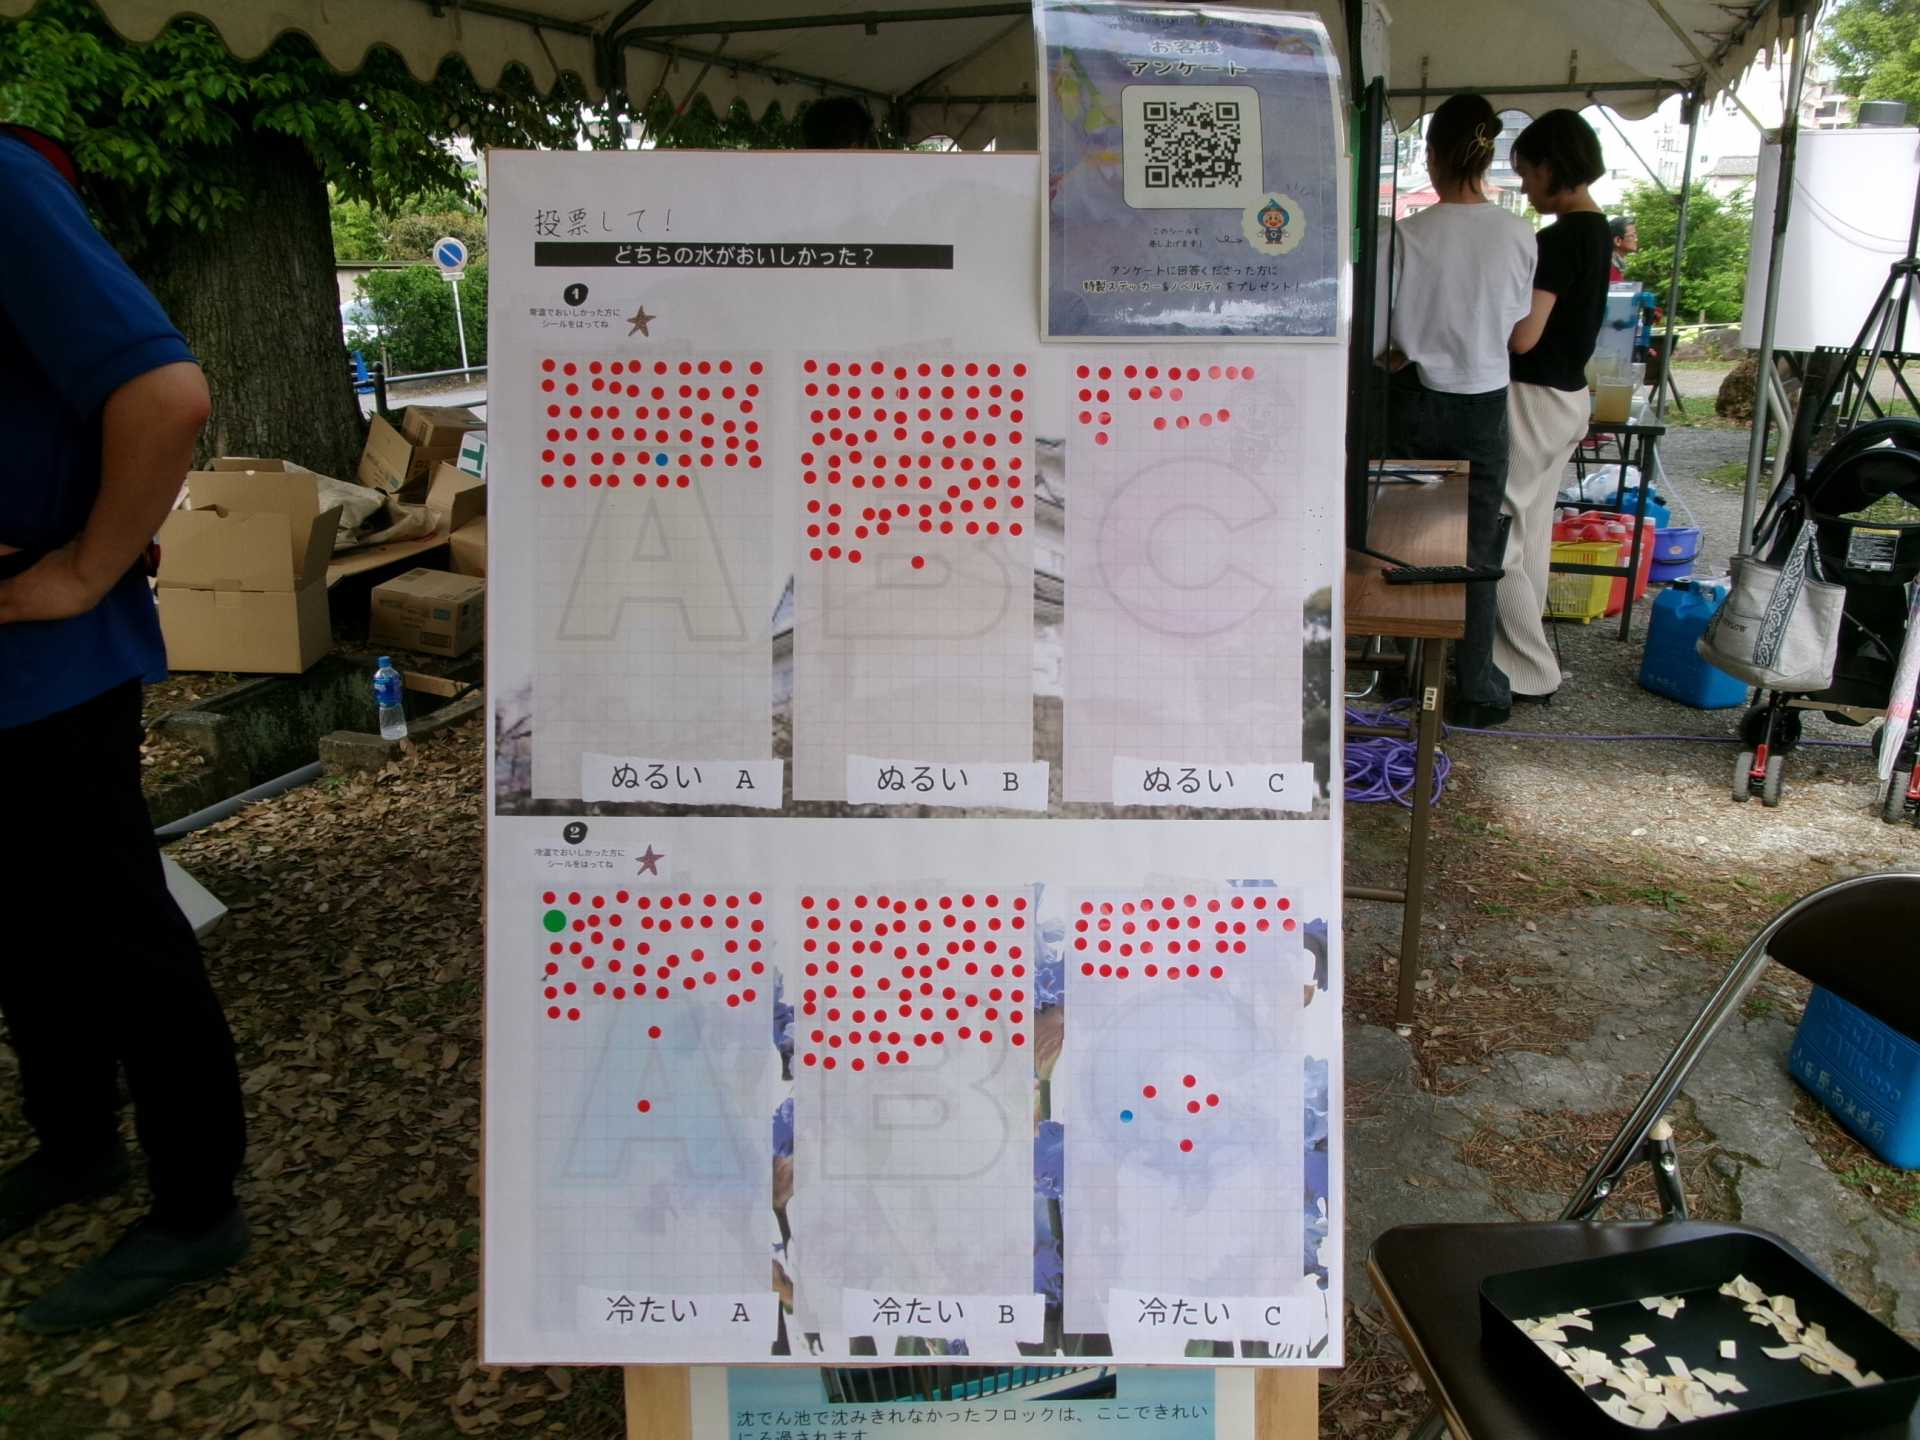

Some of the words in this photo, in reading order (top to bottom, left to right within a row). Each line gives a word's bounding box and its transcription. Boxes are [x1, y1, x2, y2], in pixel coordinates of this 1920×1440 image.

[1152, 40, 1223, 56] お客様
[1128, 60, 1248, 77] アンケート
[535, 207, 672, 238] 投票して！
[614, 245, 875, 267] どちらの水がおいしかった？
[1110, 264, 1279, 277] アンケートに回答くださった方に
[542, 320, 609, 329] シールをはってね
[1095, 456, 1279, 640] C
[611, 762, 703, 790] ぬるい
[735, 769, 756, 790] A
[876, 765, 969, 793] ぬるい
[1002, 771, 1020, 792] B
[1143, 766, 1235, 794] ぬるい
[1268, 772, 1285, 793] C
[547, 860, 614, 869] シールをはってね
[605, 1294, 698, 1325] 冷たい
[730, 1302, 751, 1322] A
[872, 1296, 964, 1326] 冷たい
[998, 1304, 1015, 1324] B
[1137, 1296, 1230, 1326] 冷たい
[1264, 1305, 1281, 1326] C
